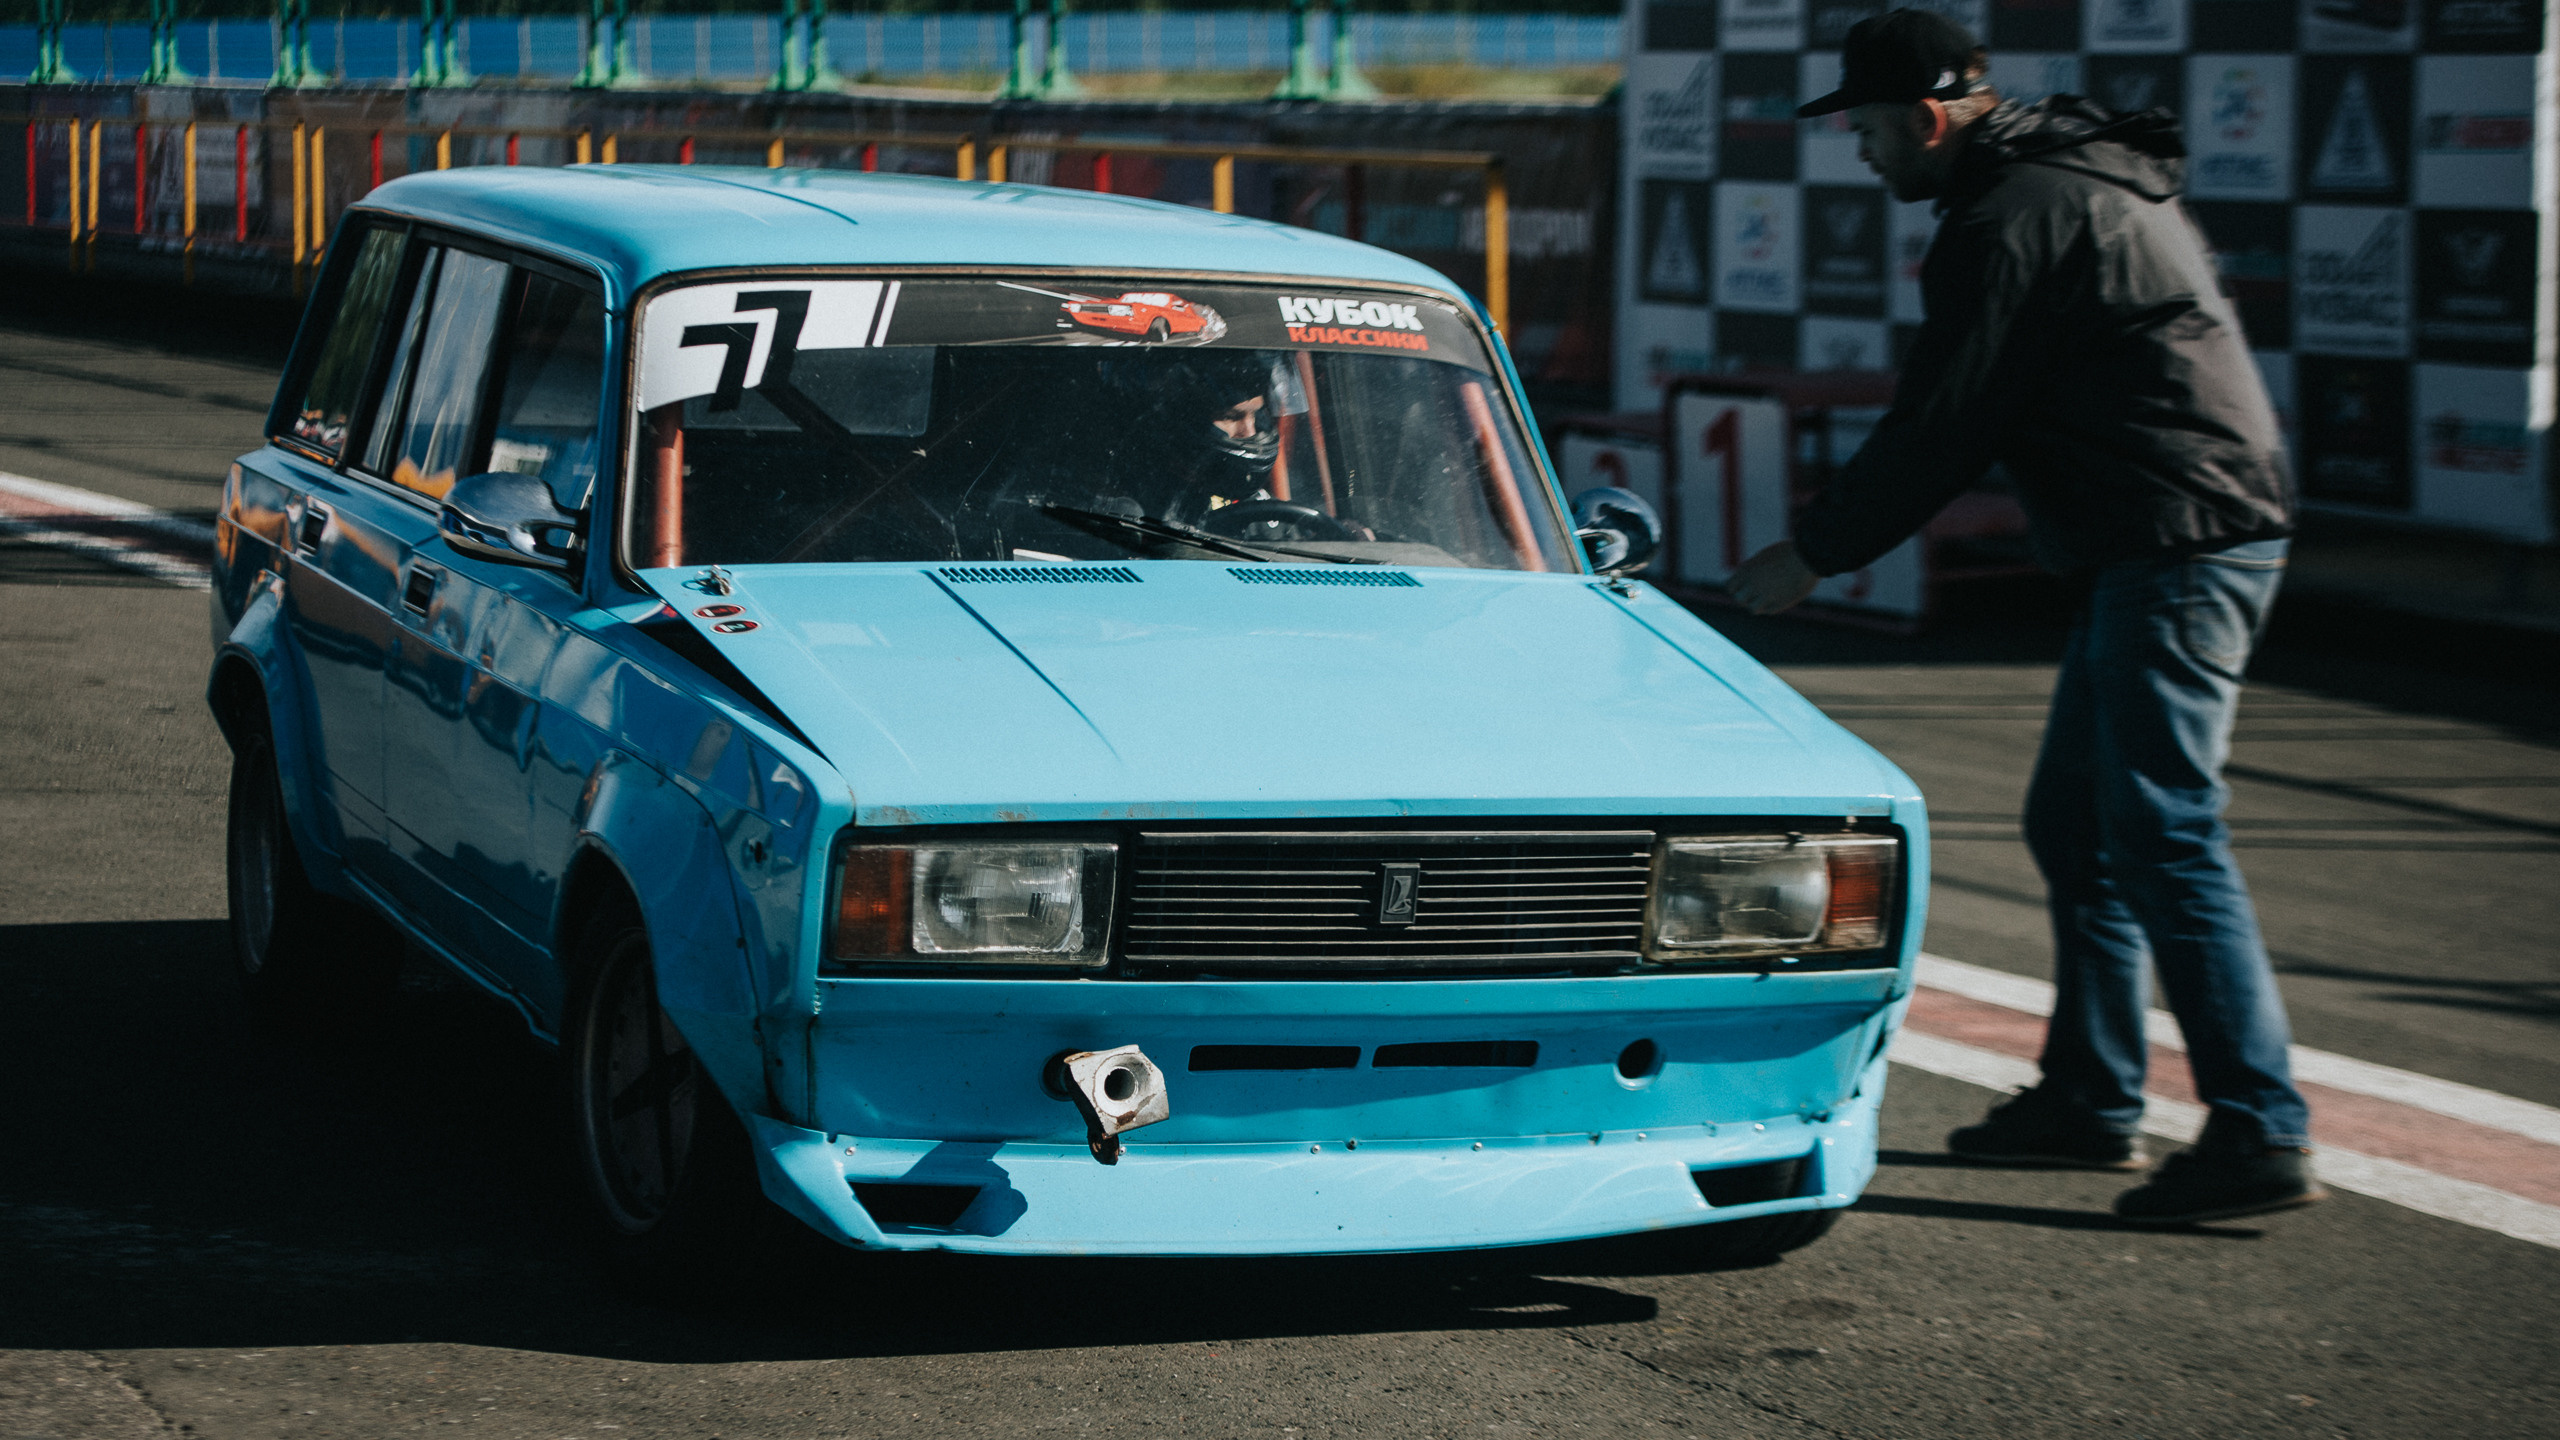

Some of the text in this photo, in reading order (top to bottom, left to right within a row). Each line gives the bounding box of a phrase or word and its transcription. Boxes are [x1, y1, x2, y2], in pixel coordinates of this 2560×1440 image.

[679, 290, 812, 412] 77
[1277, 296, 1425, 331] КУБОК
[1287, 326, 1430, 351] КЛАССИКИ
[1701, 406, 1742, 570] 1
